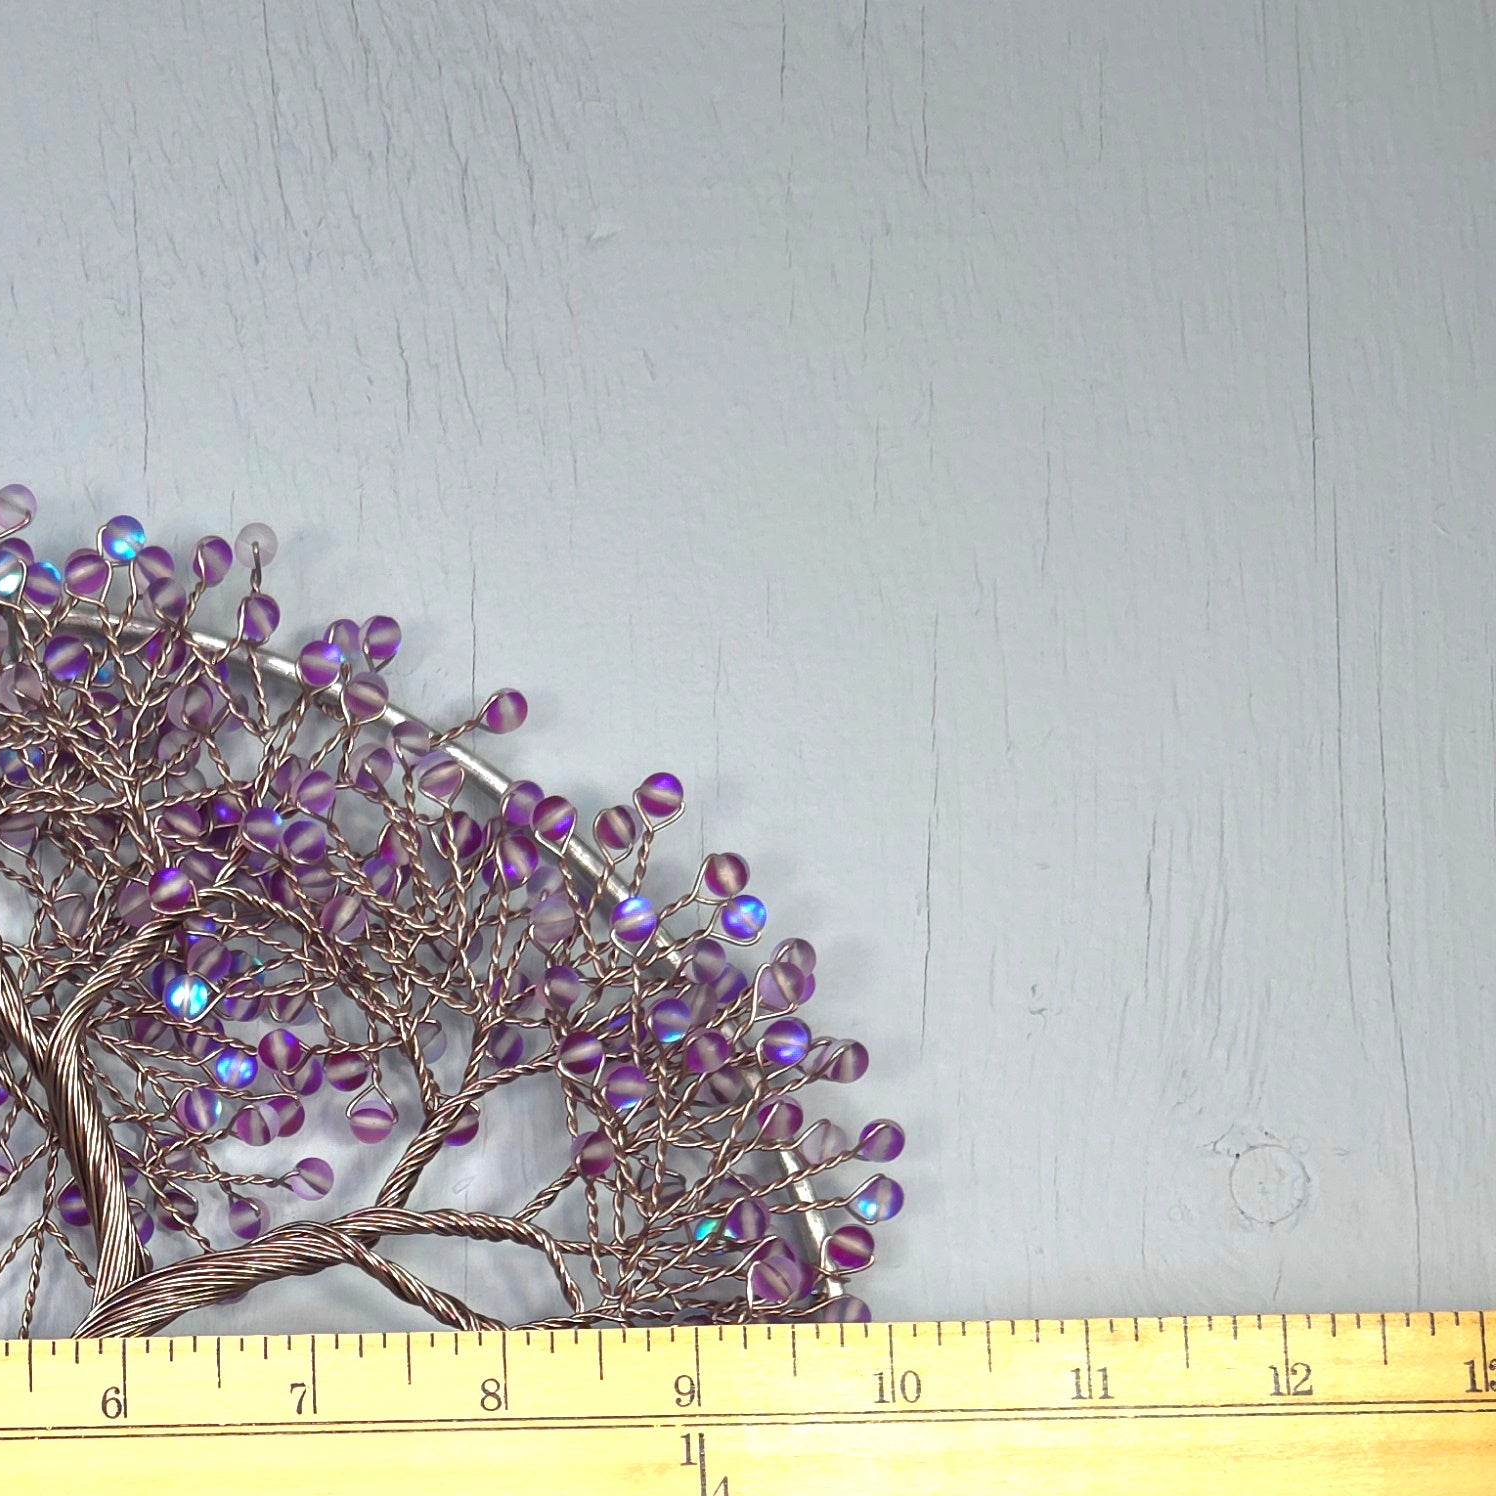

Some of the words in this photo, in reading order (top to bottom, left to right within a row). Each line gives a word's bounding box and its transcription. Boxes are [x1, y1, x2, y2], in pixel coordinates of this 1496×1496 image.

[101, 1386, 122, 1419] 6
[289, 1382, 307, 1414] 7
[480, 1378, 502, 1411] 8
[673, 1374, 696, 1407] 9
[873, 1370, 922, 1403] 10
[1070, 1366, 1112, 1400] 11
[1269, 1362, 1314, 1397] 12
